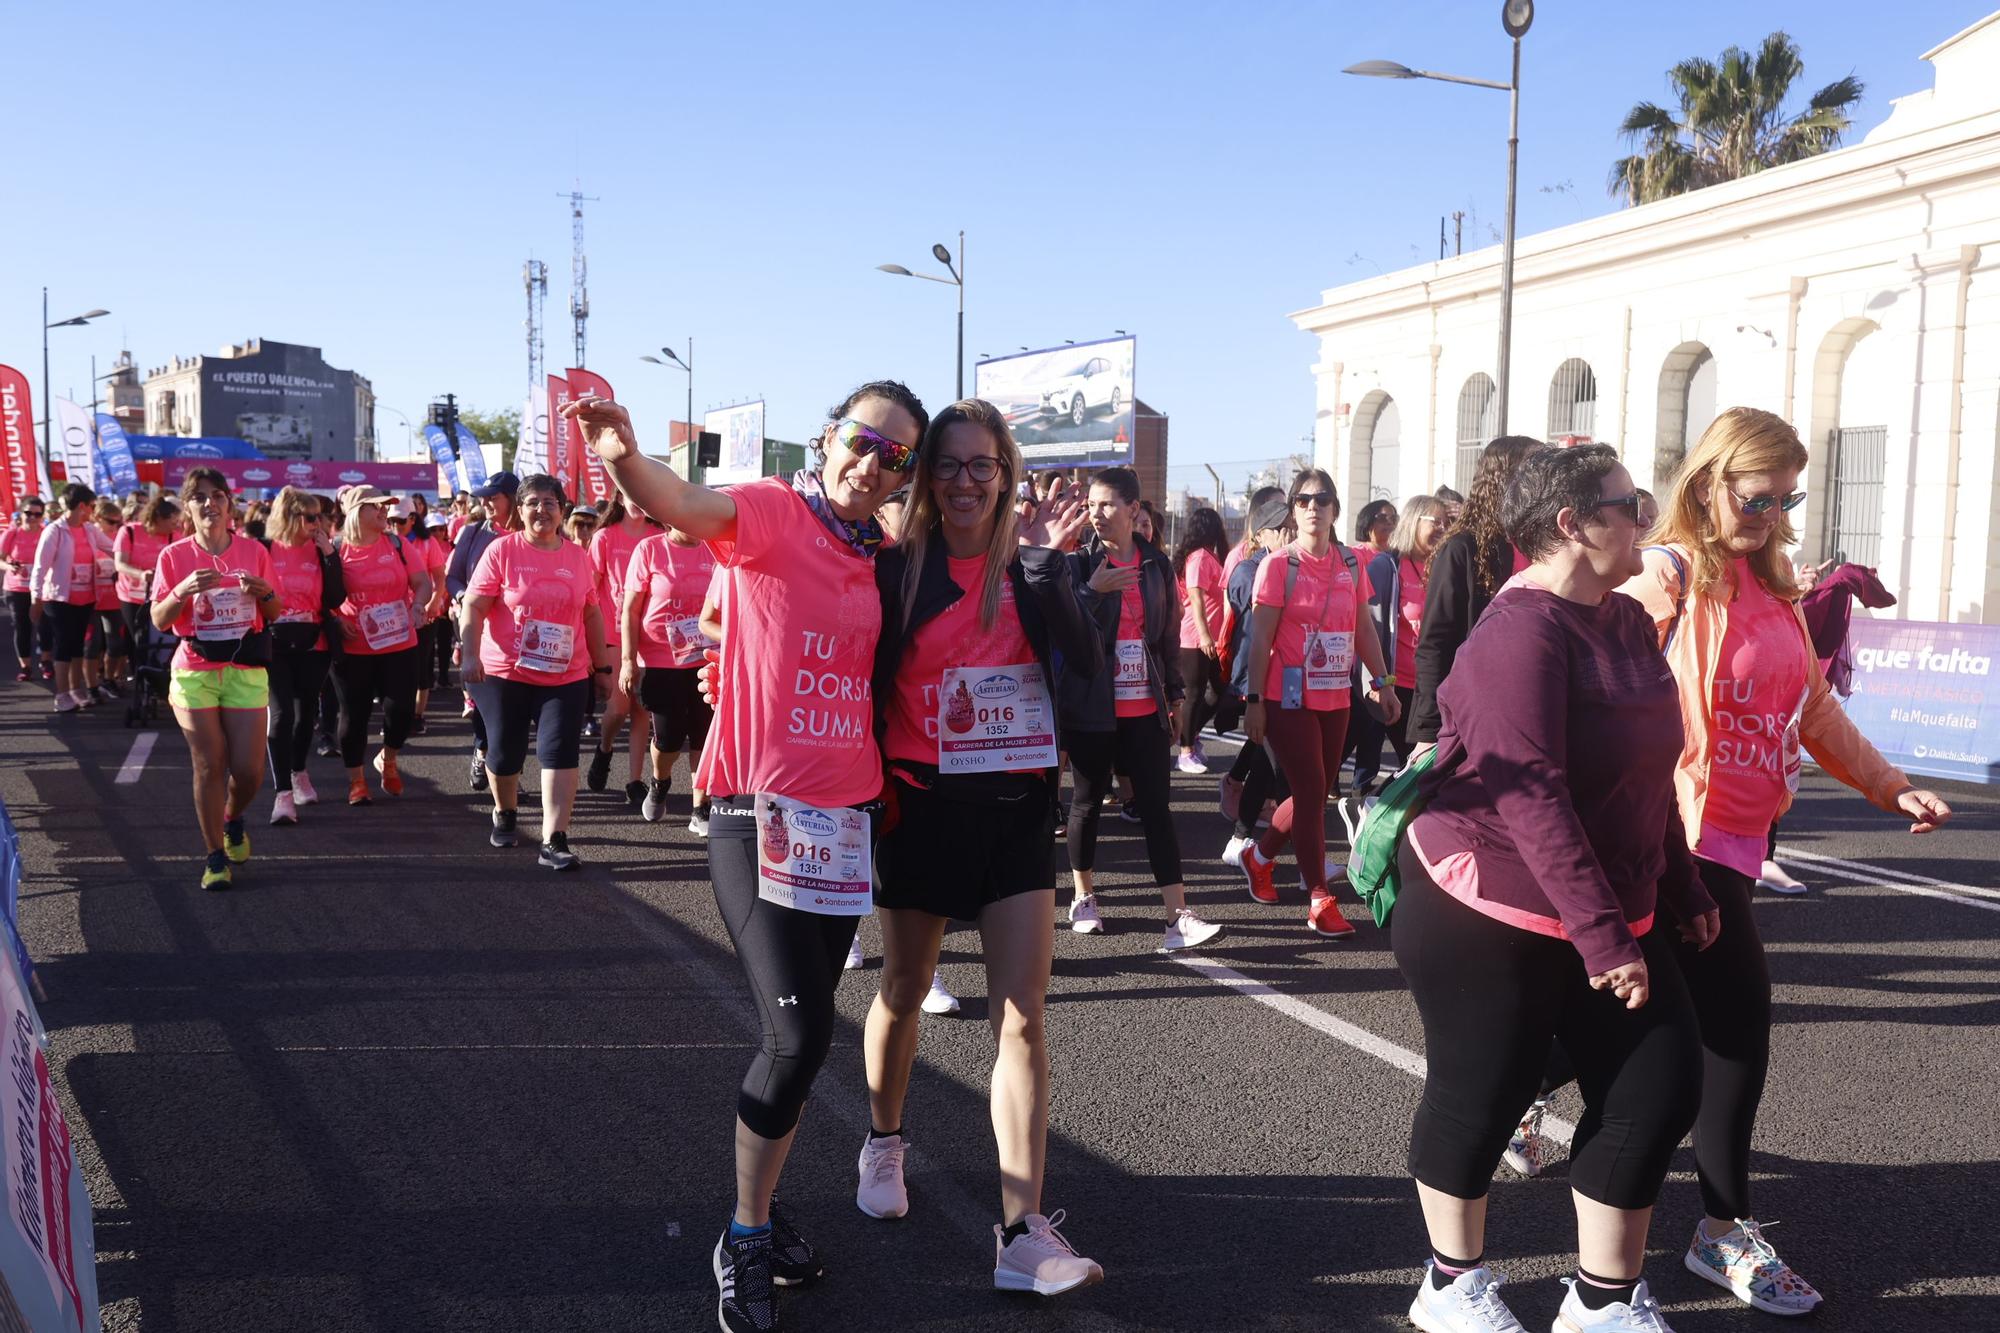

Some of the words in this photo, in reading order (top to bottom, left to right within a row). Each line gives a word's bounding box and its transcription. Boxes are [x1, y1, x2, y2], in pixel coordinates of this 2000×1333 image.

[213, 373, 224, 382] EL
[226, 372, 267, 384] PUERTO
[217, 608, 237, 617] 016
[541, 641, 559, 651] 016
[802, 630, 836, 660] TU
[1328, 654, 1345, 663] 016
[1856, 647, 1911, 673] que
[1916, 645, 1991, 675] falta
[1122, 663, 1143, 673] 016
[977, 685, 1015, 694] ASTURIANA
[1713, 679, 1753, 703] TU
[978, 706, 1014, 723] 016
[1890, 707, 1977, 729] #laMquefalta
[788, 707, 864, 739] SUMA
[985, 725, 1008, 735] 1352
[1715, 710, 1786, 739] DORS
[950, 756, 986, 766] OYSHO
[1013, 752, 1048, 761] Santander
[1714, 740, 1778, 771] SUM
[793, 816, 834, 832] ASTURIANA
[793, 842, 831, 862] 016
[798, 863, 823, 875] 1351
[769, 871, 796, 884] CARRERA
[796, 878, 807, 886] DE
[807, 880, 817, 888] LA
[818, 882, 841, 891] MUJER
[767, 884, 797, 901] OYSHO
[824, 896, 863, 906] Santander
